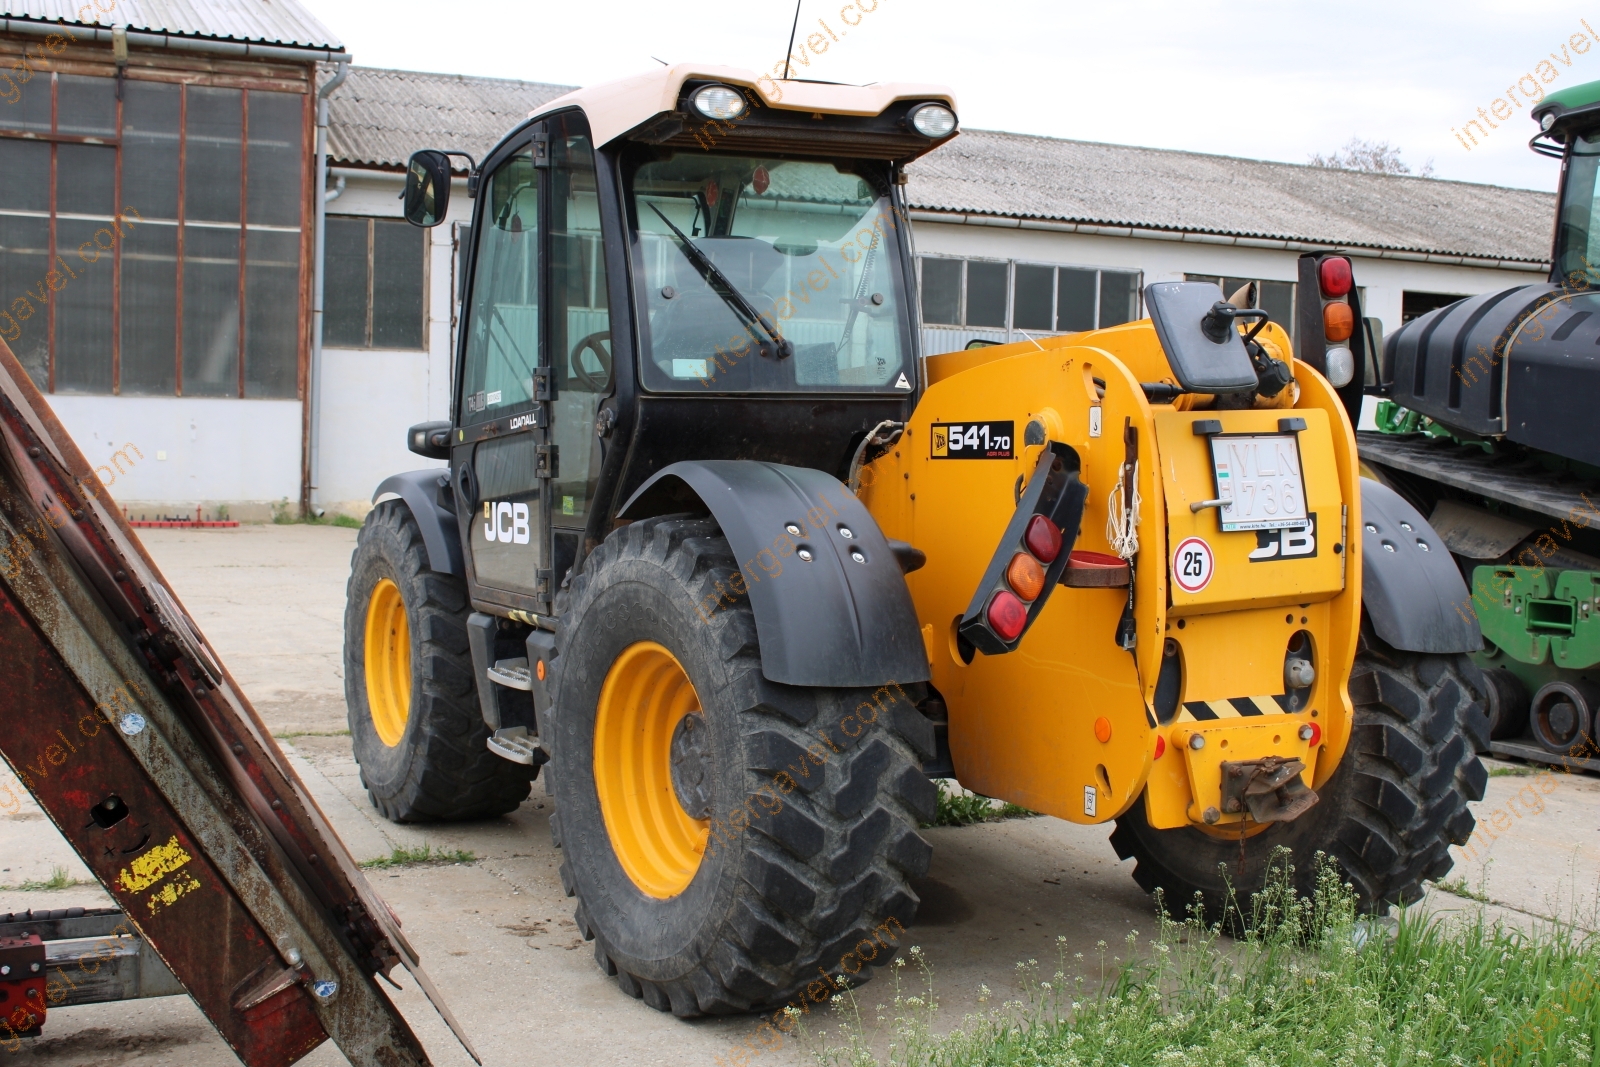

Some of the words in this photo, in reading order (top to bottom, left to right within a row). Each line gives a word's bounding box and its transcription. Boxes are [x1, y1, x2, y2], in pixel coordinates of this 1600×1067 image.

[510, 413, 537, 430] LOADALL
[1231, 442, 1298, 477] YLN
[1241, 479, 1297, 515] 736
[484, 501, 530, 545] JCB
[1183, 551, 1203, 577] 25
